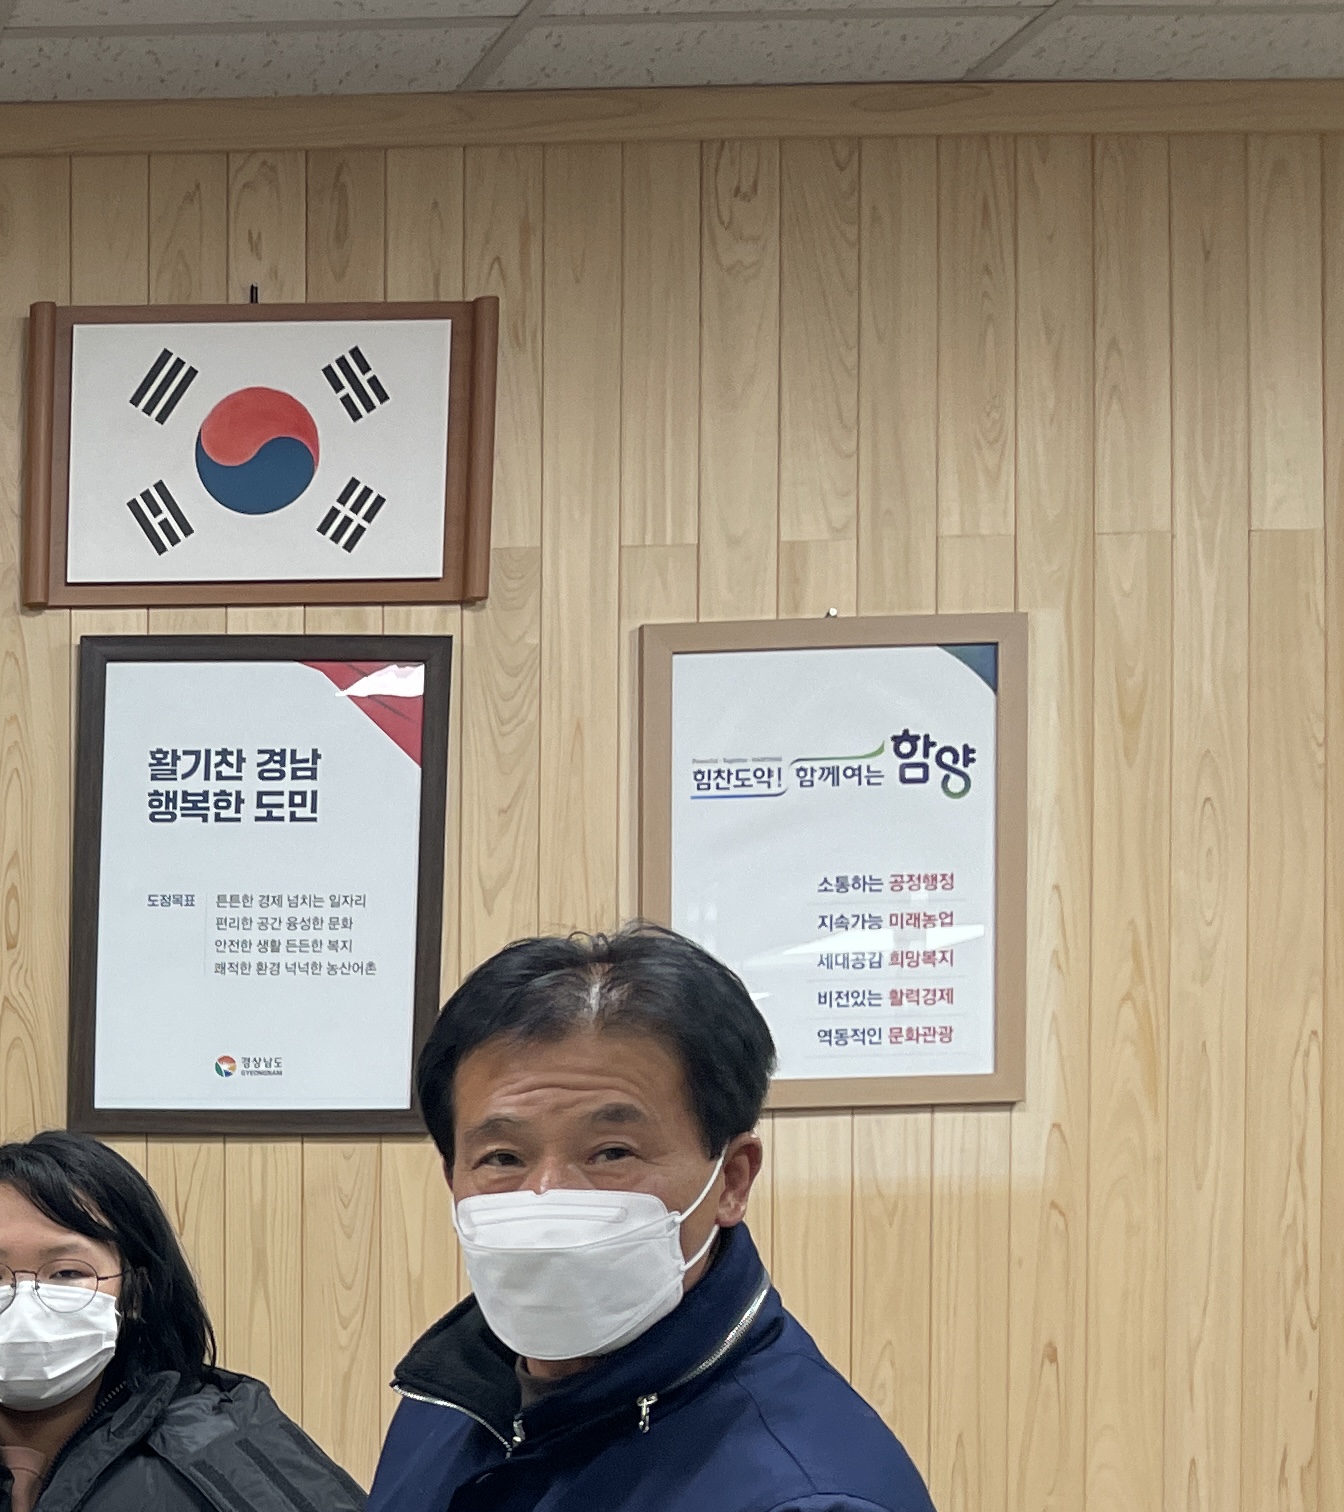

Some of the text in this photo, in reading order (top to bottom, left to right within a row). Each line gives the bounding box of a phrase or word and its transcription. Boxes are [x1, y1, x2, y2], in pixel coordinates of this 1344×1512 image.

[148, 748, 322, 781] 활기찬 경남
[692, 728, 977, 800] 힘찬도약! 함께여는 함양
[147, 789, 318, 823] 행복한 도민
[817, 872, 954, 894] 소통하는 공정행정
[147, 894, 195, 907] 도정목표
[258, 894, 283, 908] 경제
[287, 894, 325, 908] 넘치는
[329, 894, 366, 908] 일자리
[216, 916, 353, 931] 편리한 공간 융성한 문화
[817, 911, 954, 932] 지속가능 미래농업
[214, 939, 352, 953] 안전한 생활 든든한 복지
[214, 961, 377, 976] 쾌적한 환경 넉넉한 농산어촌
[817, 948, 954, 970] 세대공감 희망복지
[817, 987, 954, 1008] 비전있는 활력경제
[817, 1025, 954, 1047] 역동적인 문화관광
[240, 1056, 283, 1069] 경상남도
